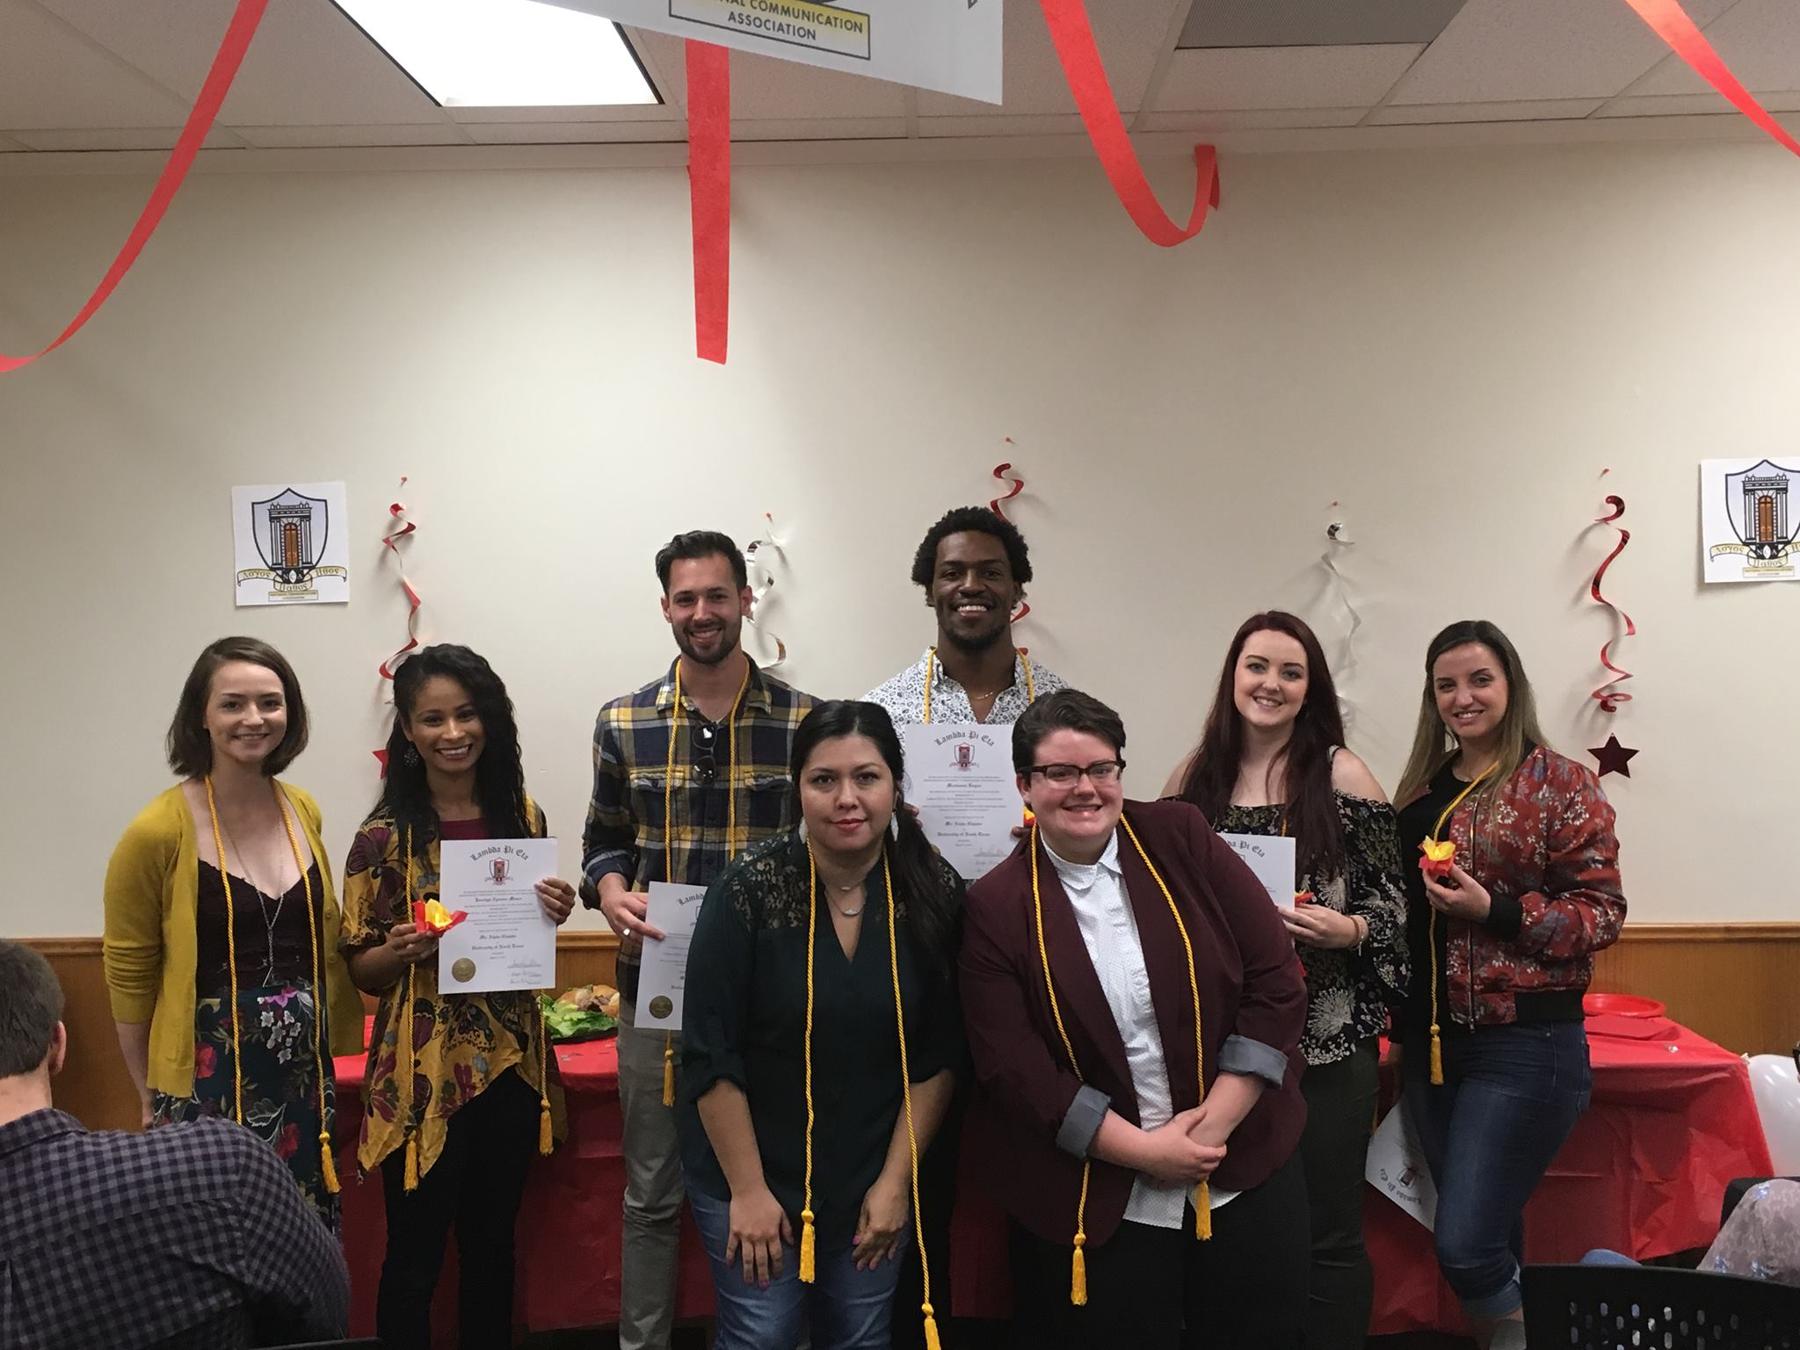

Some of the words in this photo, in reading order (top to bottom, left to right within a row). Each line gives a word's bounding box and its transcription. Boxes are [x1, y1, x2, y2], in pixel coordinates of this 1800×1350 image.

[727, 11, 816, 41] ASSOCIATION
[750, 0, 863, 34] COMMUNICATION
[933, 731, 966, 746] Lambda
[968, 730, 980, 740] Pi
[981, 734, 995, 747] Eta
[469, 846, 501, 861] Lambda
[503, 845, 514, 854] Pi
[515, 848, 529, 861] Eta
